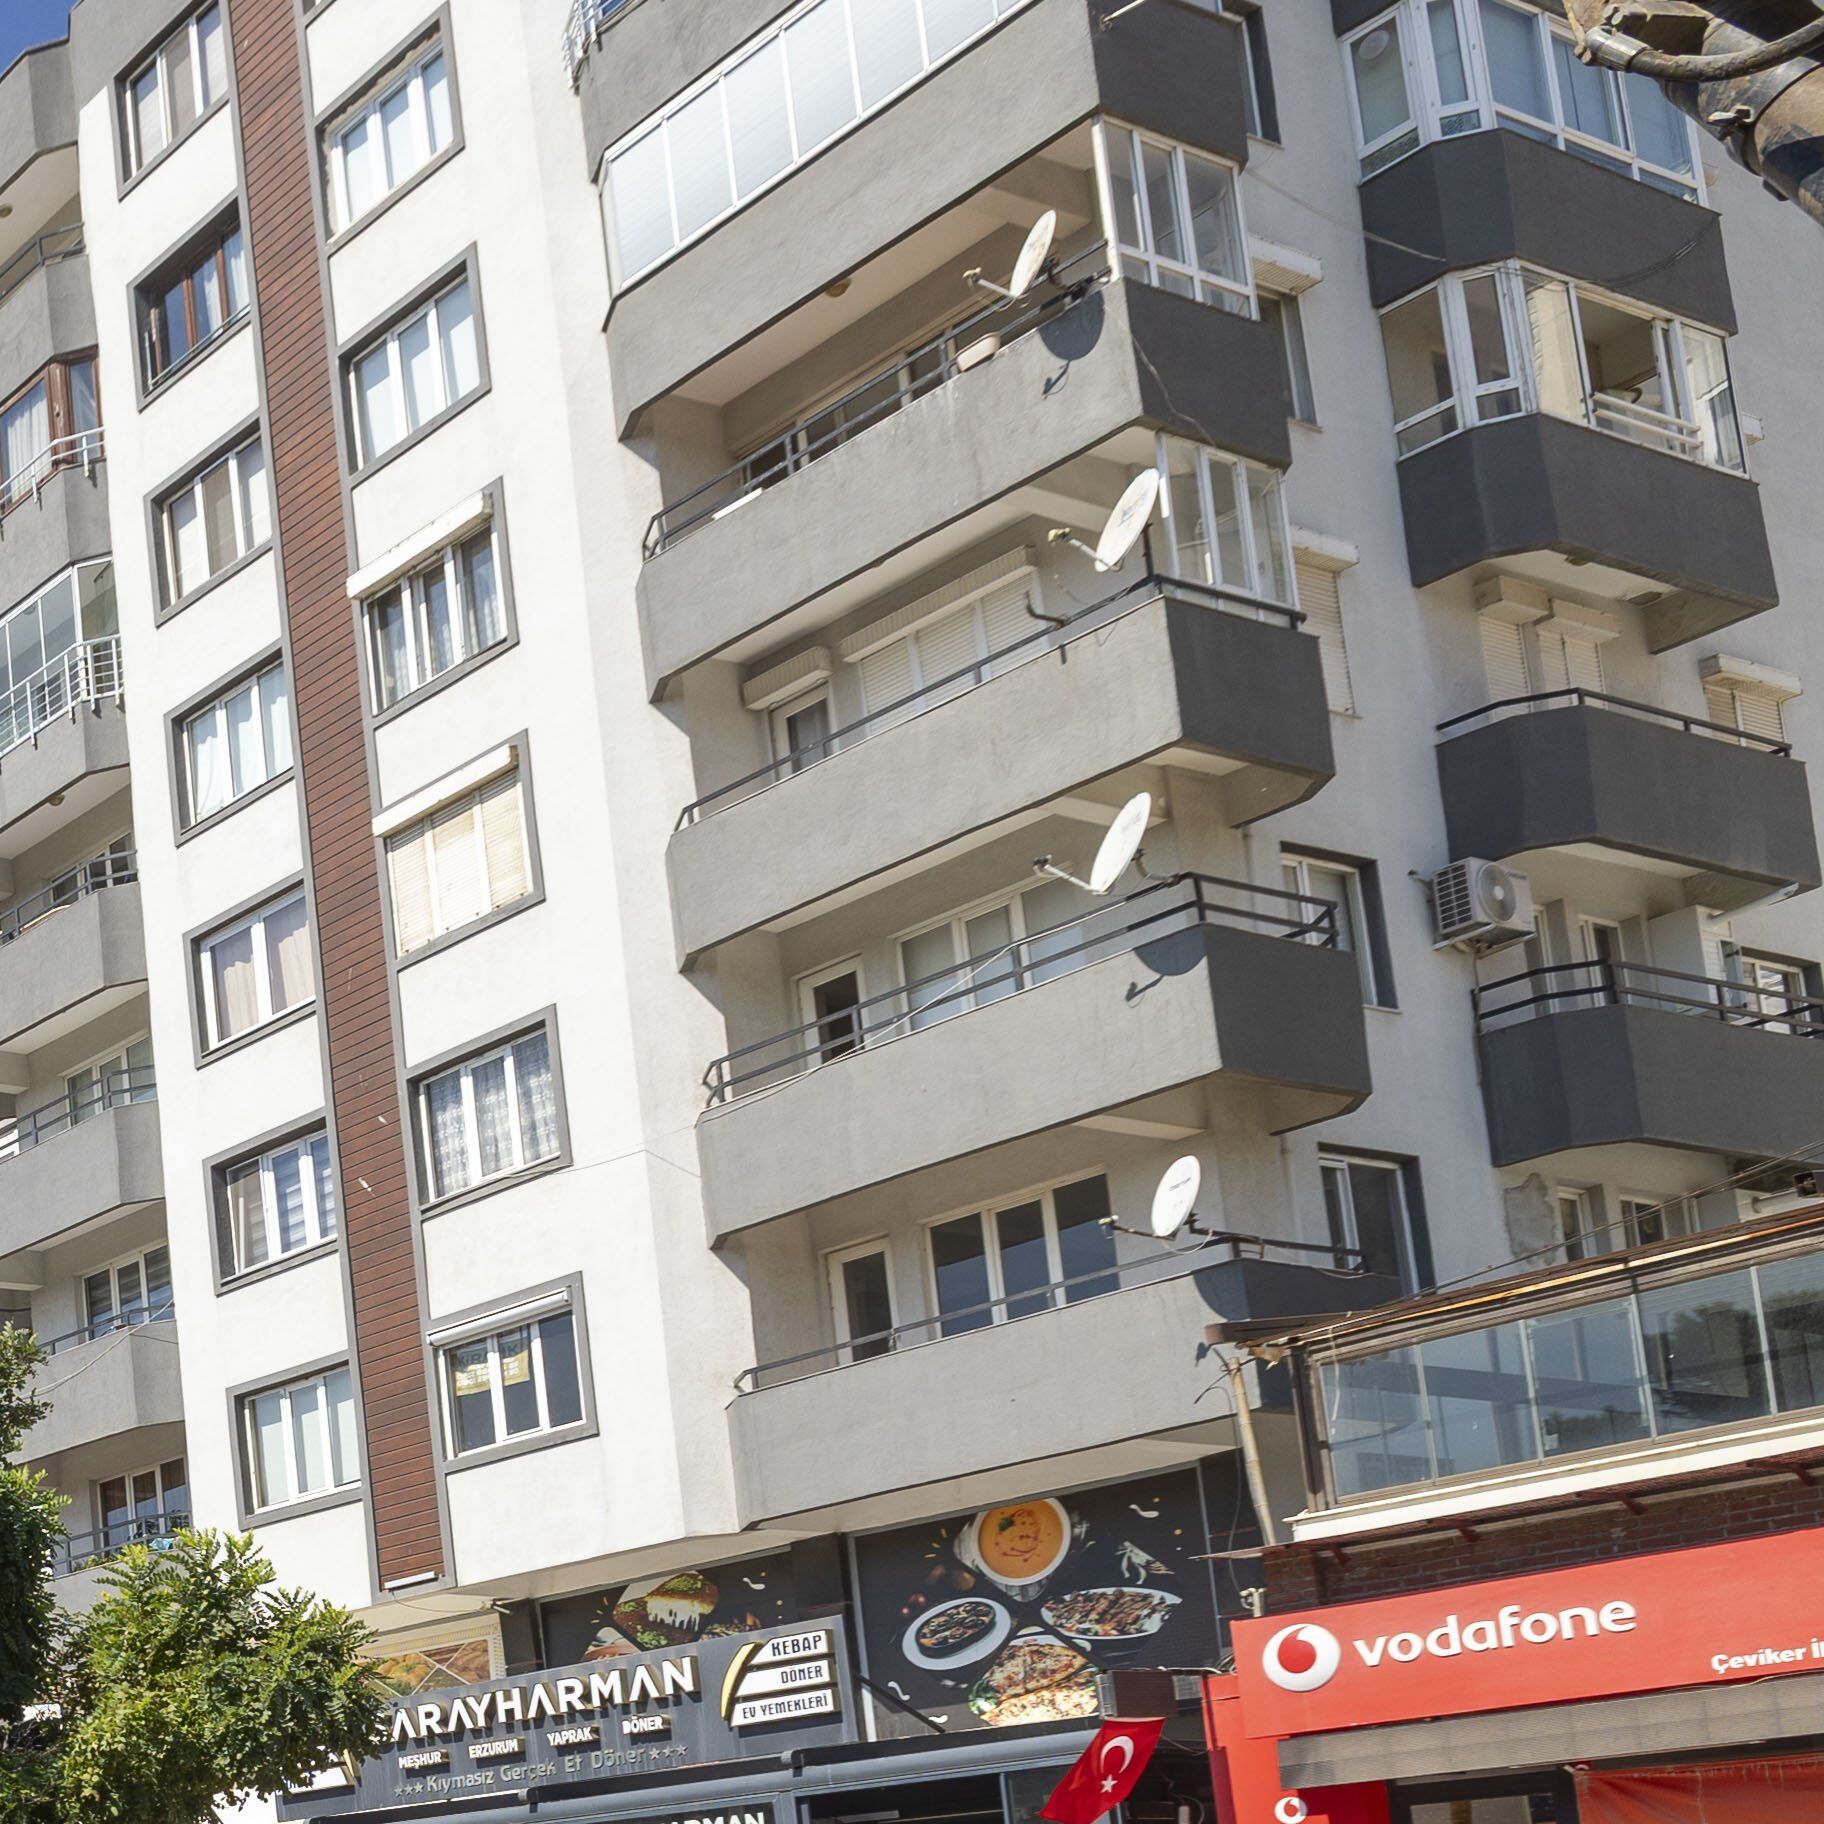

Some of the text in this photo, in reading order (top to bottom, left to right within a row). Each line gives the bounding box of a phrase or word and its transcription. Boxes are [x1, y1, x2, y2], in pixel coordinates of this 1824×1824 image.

[772, 1635, 822, 1657] KEBAP
[1353, 1600, 1637, 1668] vodafone
[1711, 1647, 1807, 1674] Çeviker
[781, 1665, 824, 1684] DÖNER
[743, 1693, 829, 1719] EV YEMEKLERİ
[398, 1715, 664, 1769] MEŞHUR ERZURUM YAPRAK DÖNER
[500, 1762, 556, 1783] Gerçek
[564, 1754, 583, 1773] Et
[592, 1750, 646, 1769] Döner
